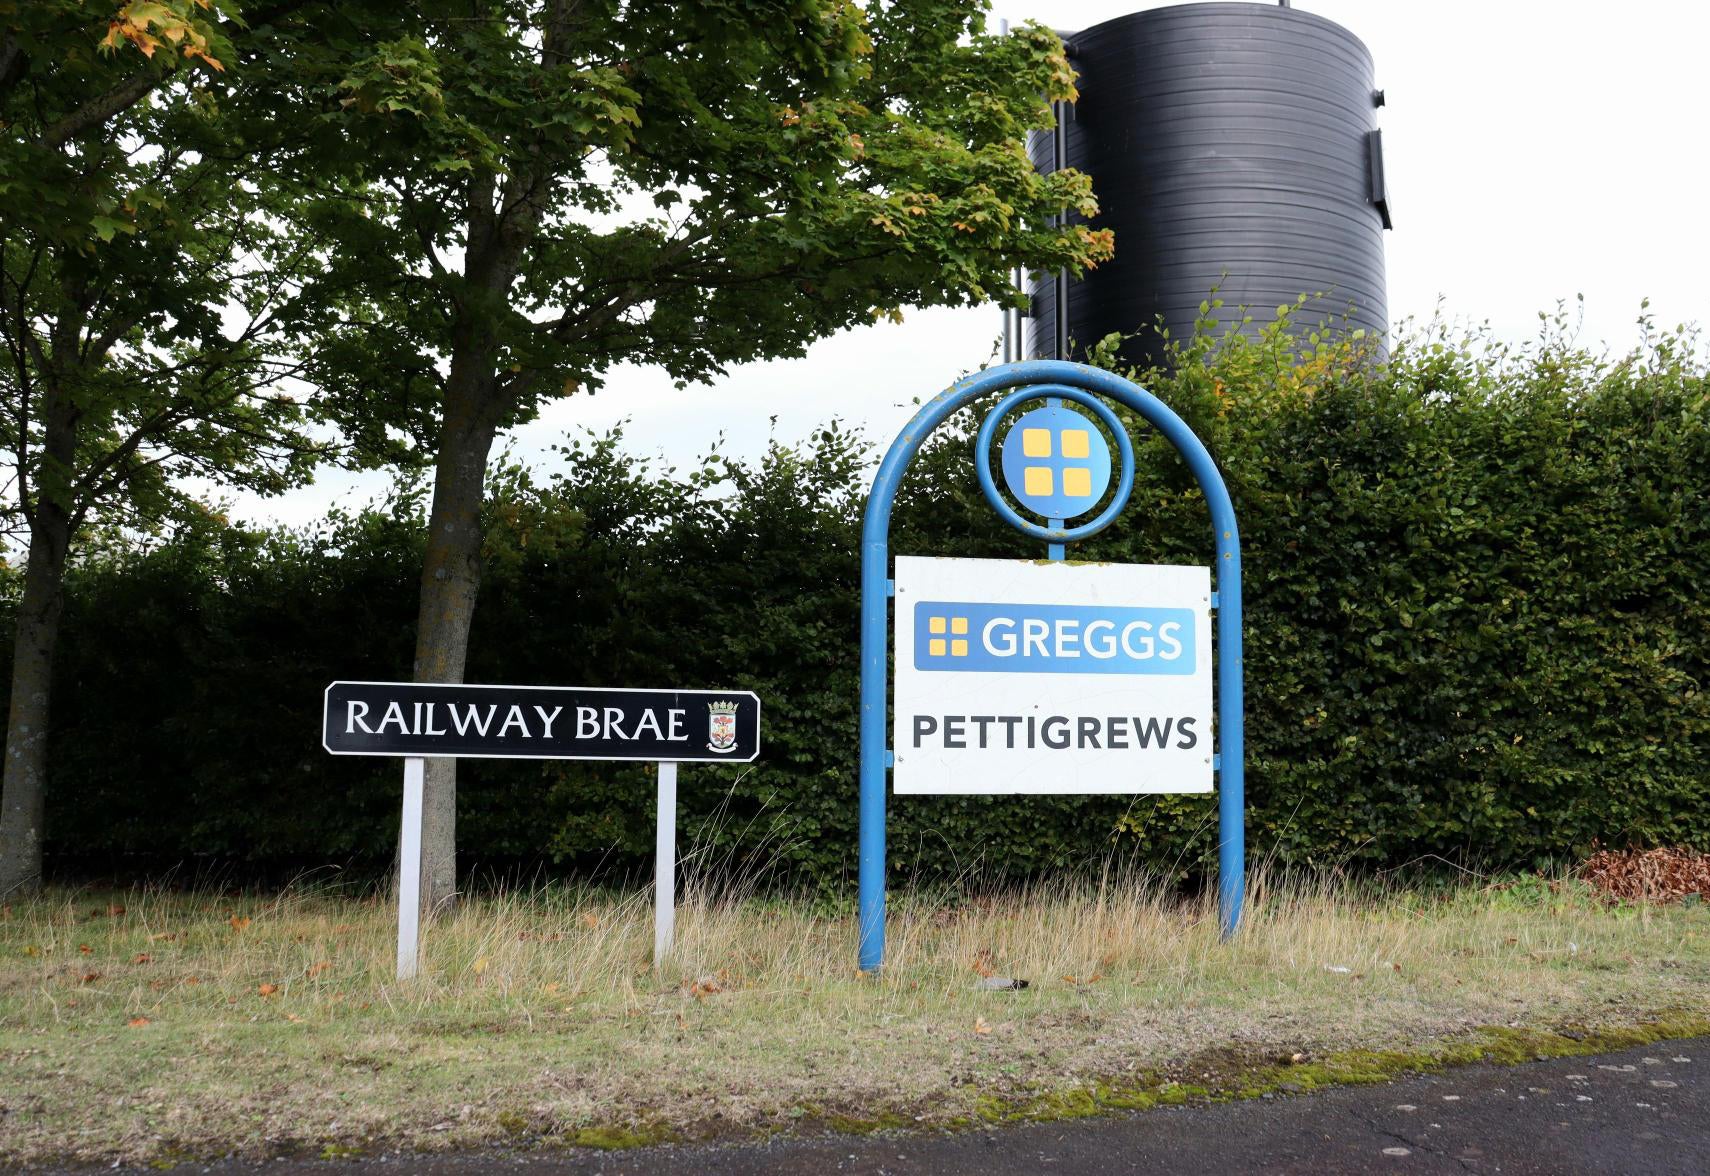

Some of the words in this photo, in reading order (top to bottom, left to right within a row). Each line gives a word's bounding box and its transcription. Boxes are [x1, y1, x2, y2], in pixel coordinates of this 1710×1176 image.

[982, 617, 1183, 660] GREGGS
[344, 700, 564, 738] RAILWAY
[575, 706, 690, 741] BRAE
[912, 714, 1198, 750] PETTIGREWS
